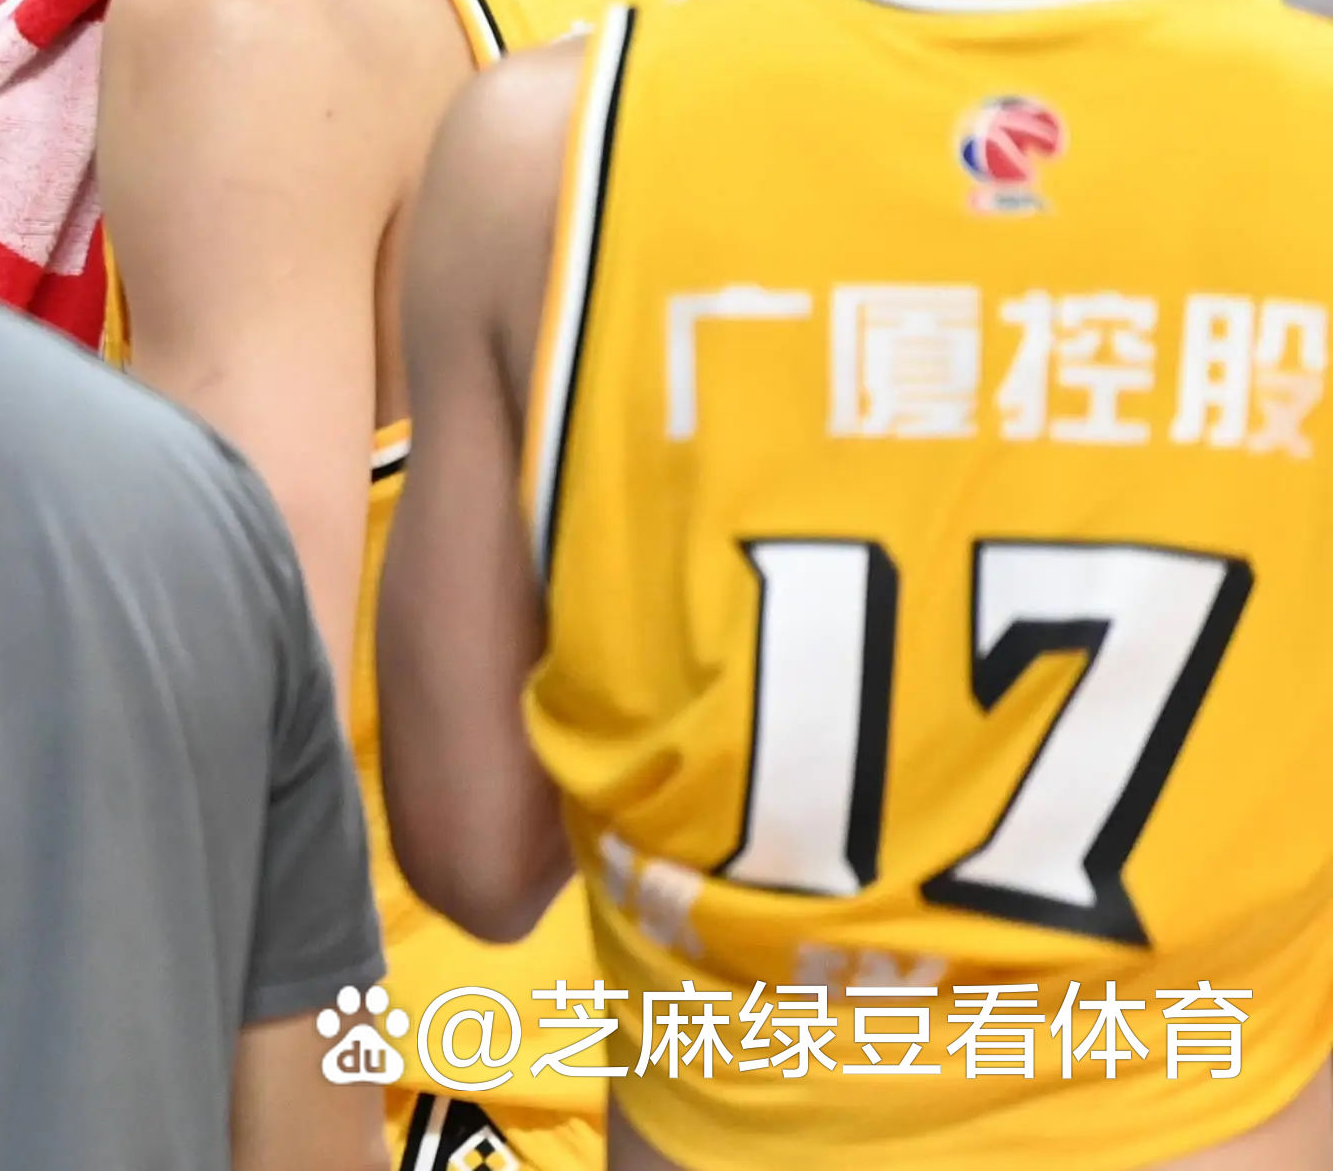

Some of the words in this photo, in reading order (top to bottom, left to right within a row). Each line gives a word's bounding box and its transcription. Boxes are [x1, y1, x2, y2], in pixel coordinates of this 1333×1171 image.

[664, 282, 1331, 460] 广厦控股
[712, 533, 1257, 951] 17
